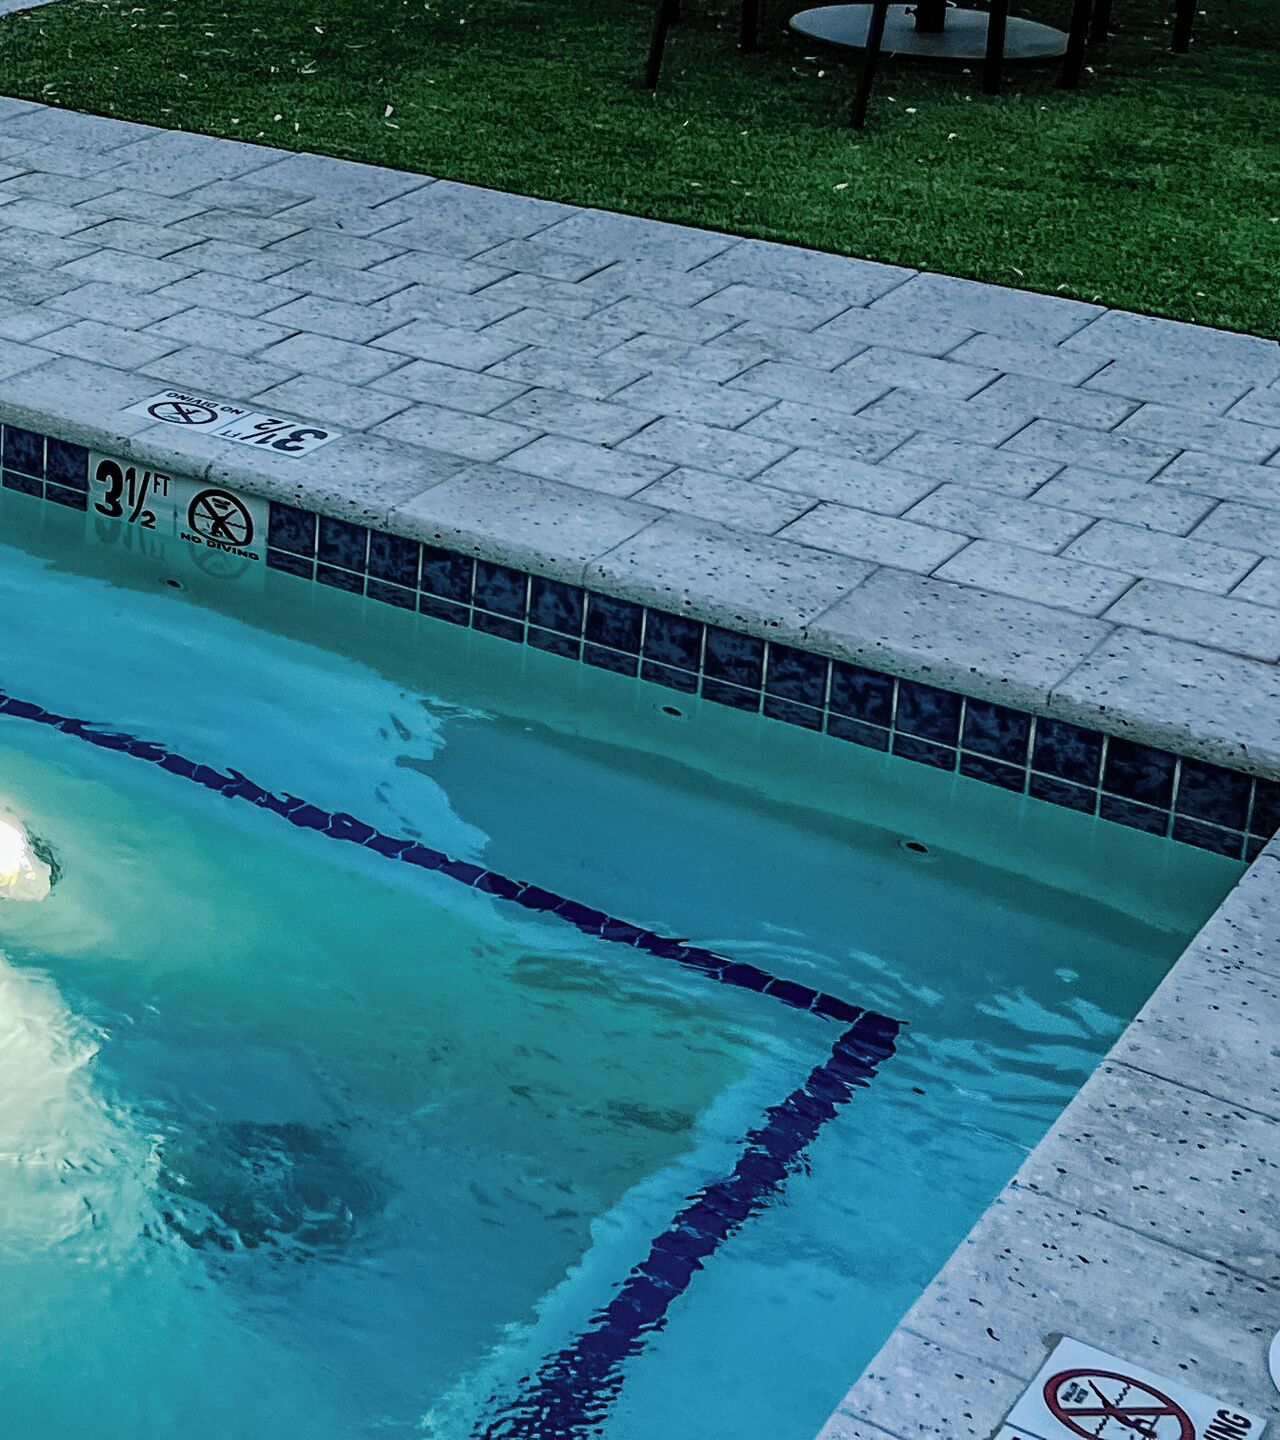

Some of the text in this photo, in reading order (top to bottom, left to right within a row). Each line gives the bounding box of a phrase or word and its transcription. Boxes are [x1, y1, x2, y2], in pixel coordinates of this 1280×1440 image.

[166, 392, 245, 415] NO DIVING
[153, 472, 171, 497] FT
[181, 532, 259, 560] NO DIVING
[1203, 1409, 1252, 1440] ING
